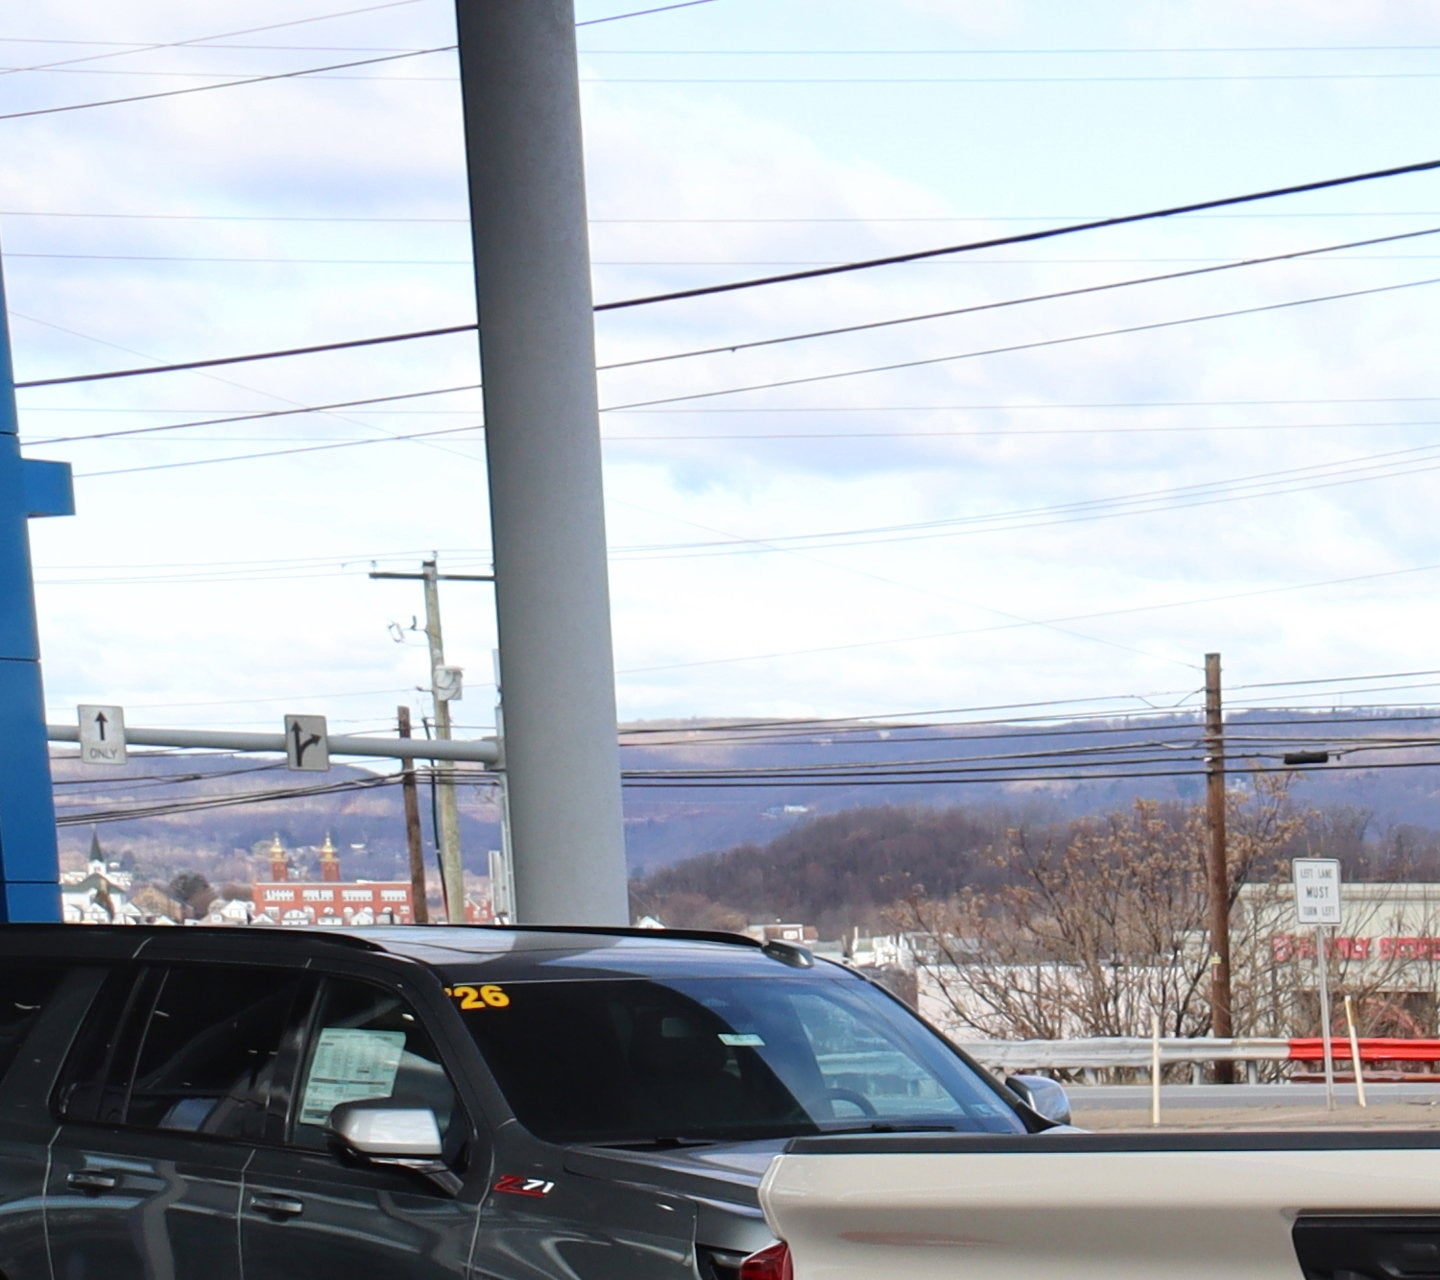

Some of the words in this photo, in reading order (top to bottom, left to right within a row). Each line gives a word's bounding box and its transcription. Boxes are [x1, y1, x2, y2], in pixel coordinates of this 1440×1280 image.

[89, 747, 118, 760] ONLY
[1306, 886, 1330, 899] MUST
[492, 1173, 555, 1198] Z71
